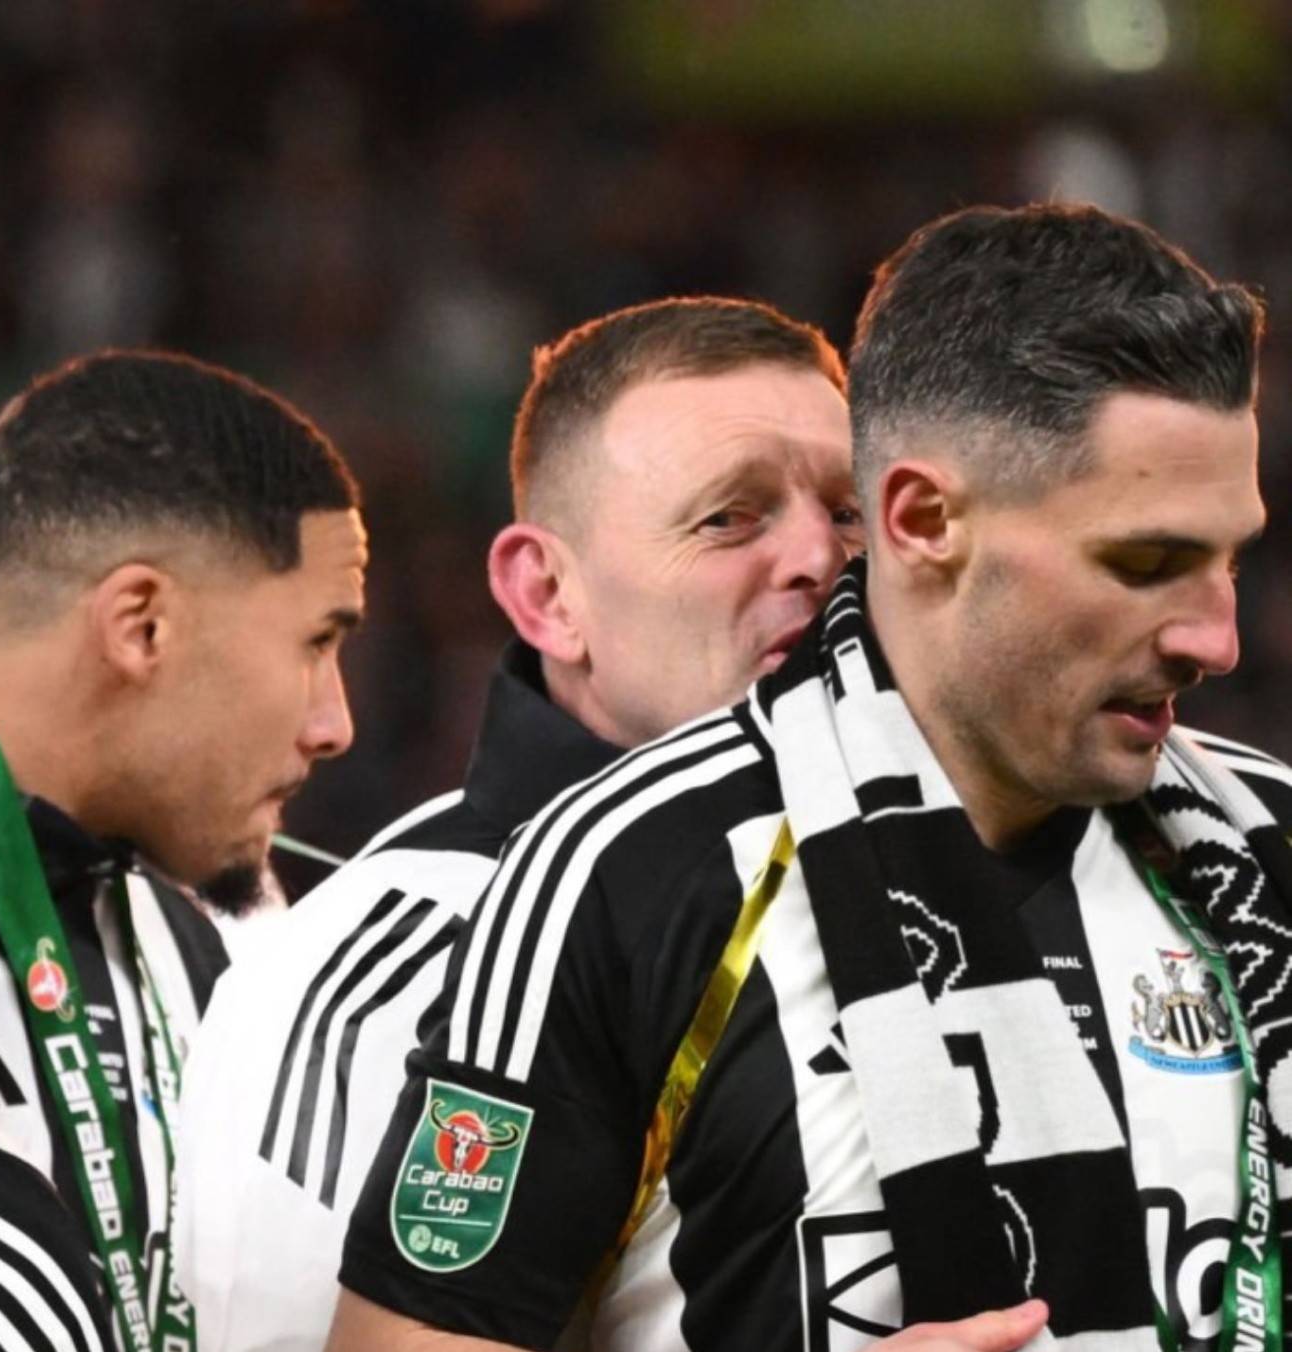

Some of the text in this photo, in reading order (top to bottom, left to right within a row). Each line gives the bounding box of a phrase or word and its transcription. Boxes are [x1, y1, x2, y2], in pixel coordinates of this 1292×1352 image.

[1042, 955, 1084, 969] FINAL
[44, 1033, 124, 1241] Carabao
[406, 1163, 504, 1193] Carabao
[1241, 1098, 1271, 1264] ENERGY
[422, 1189, 470, 1216] Cup
[429, 1235, 461, 1260] EFL
